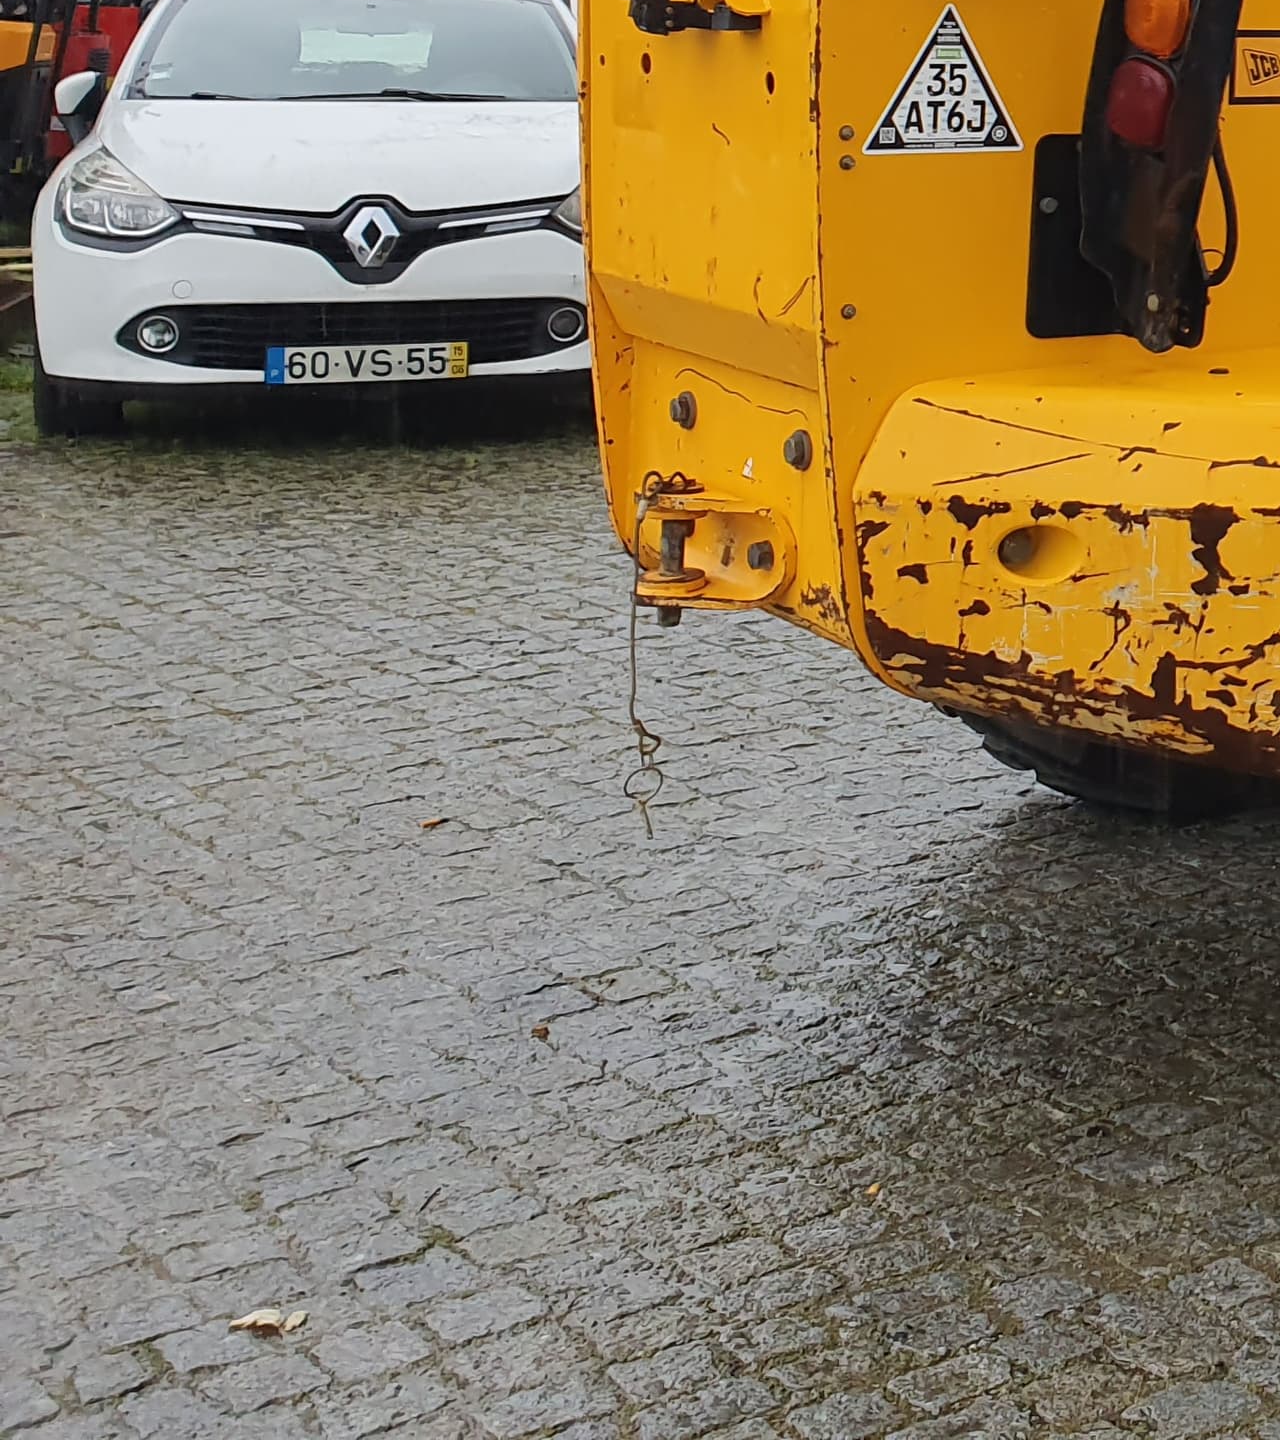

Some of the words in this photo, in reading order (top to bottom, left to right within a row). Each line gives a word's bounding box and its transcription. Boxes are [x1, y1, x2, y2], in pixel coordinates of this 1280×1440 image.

[926, 63, 968, 97] 35
[1249, 53, 1280, 78] JCB
[903, 99, 987, 134] AT6J
